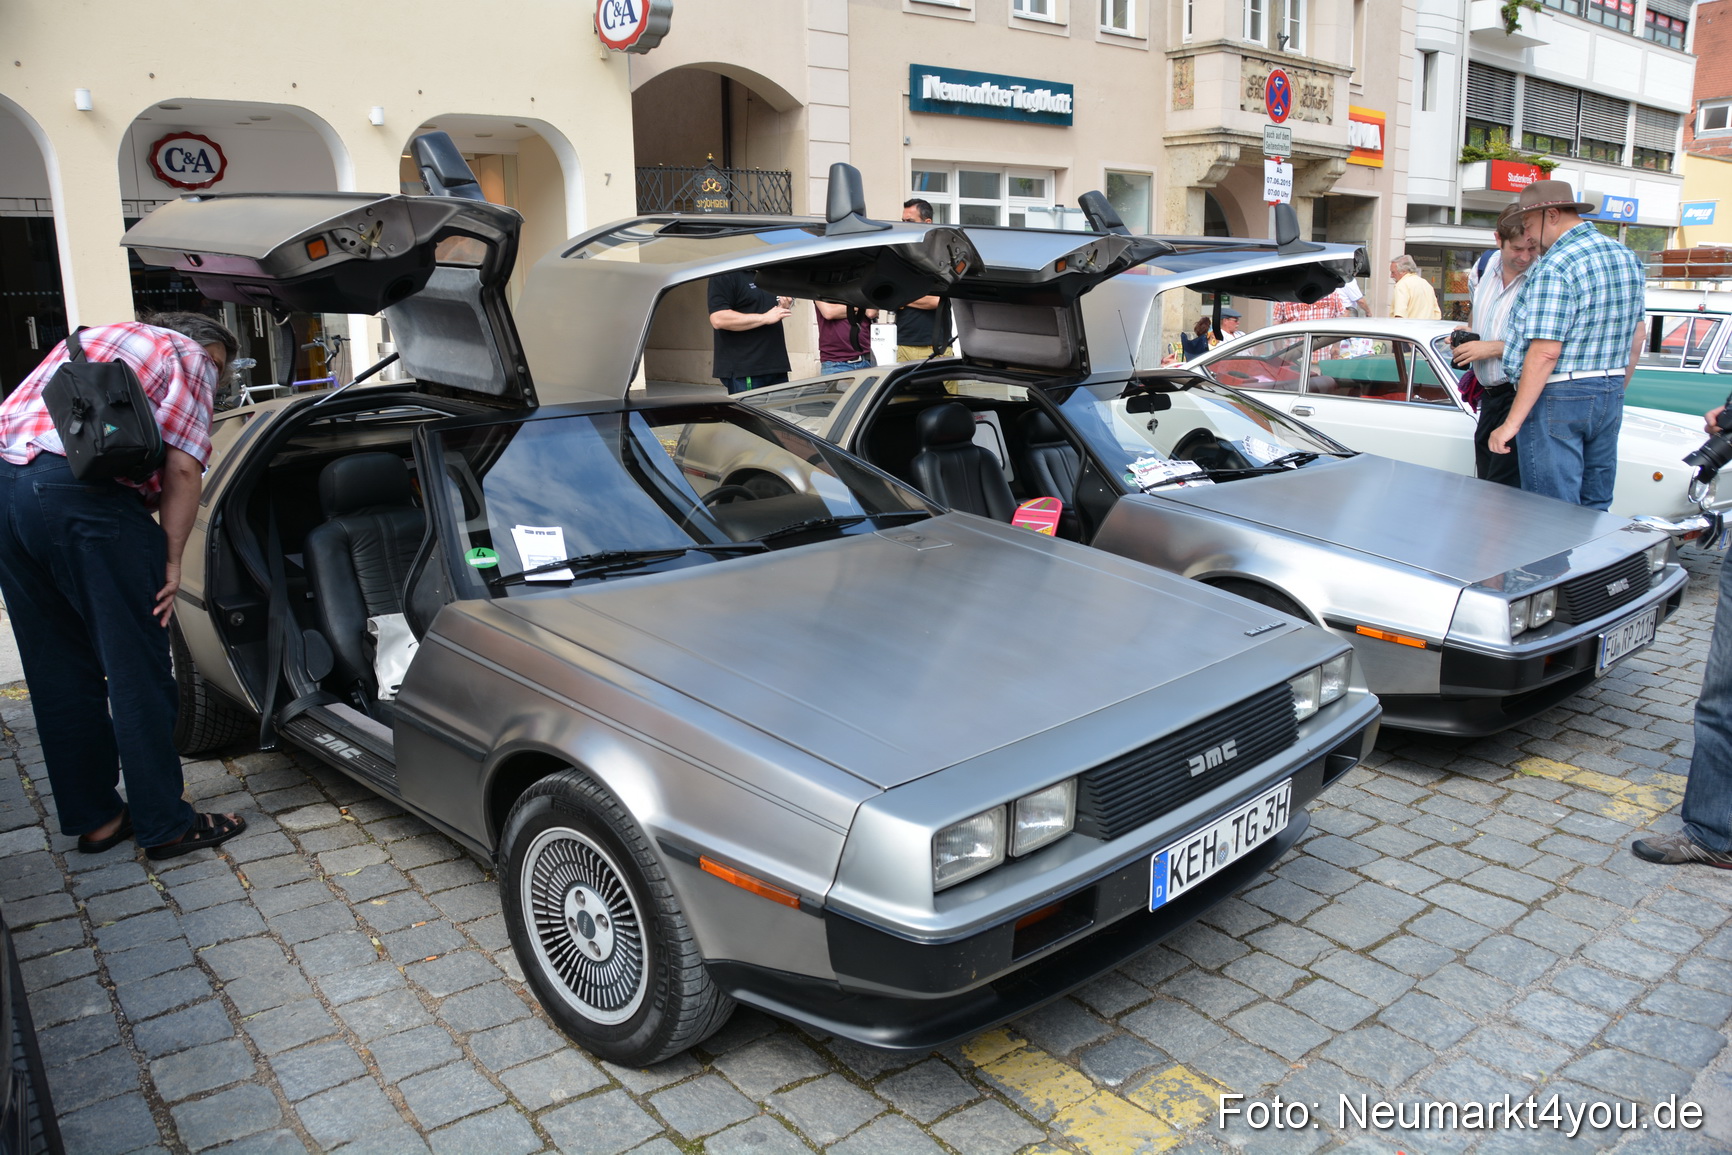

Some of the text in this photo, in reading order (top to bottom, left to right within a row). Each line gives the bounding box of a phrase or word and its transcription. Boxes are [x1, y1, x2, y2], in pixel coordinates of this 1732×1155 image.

[603, 0, 638, 30] C&A
[922, 74, 1073, 114] Neumarkter Tagblatt
[164, 147, 216, 174] C&A
[604, 172, 612, 186] 7
[476, 548, 486, 558] 4
[1622, 624, 1634, 652] RP
[1634, 612, 1656, 645] 211H
[1169, 788, 1289, 894] KEH TG 3H
[1156, 885, 1162, 898] D
